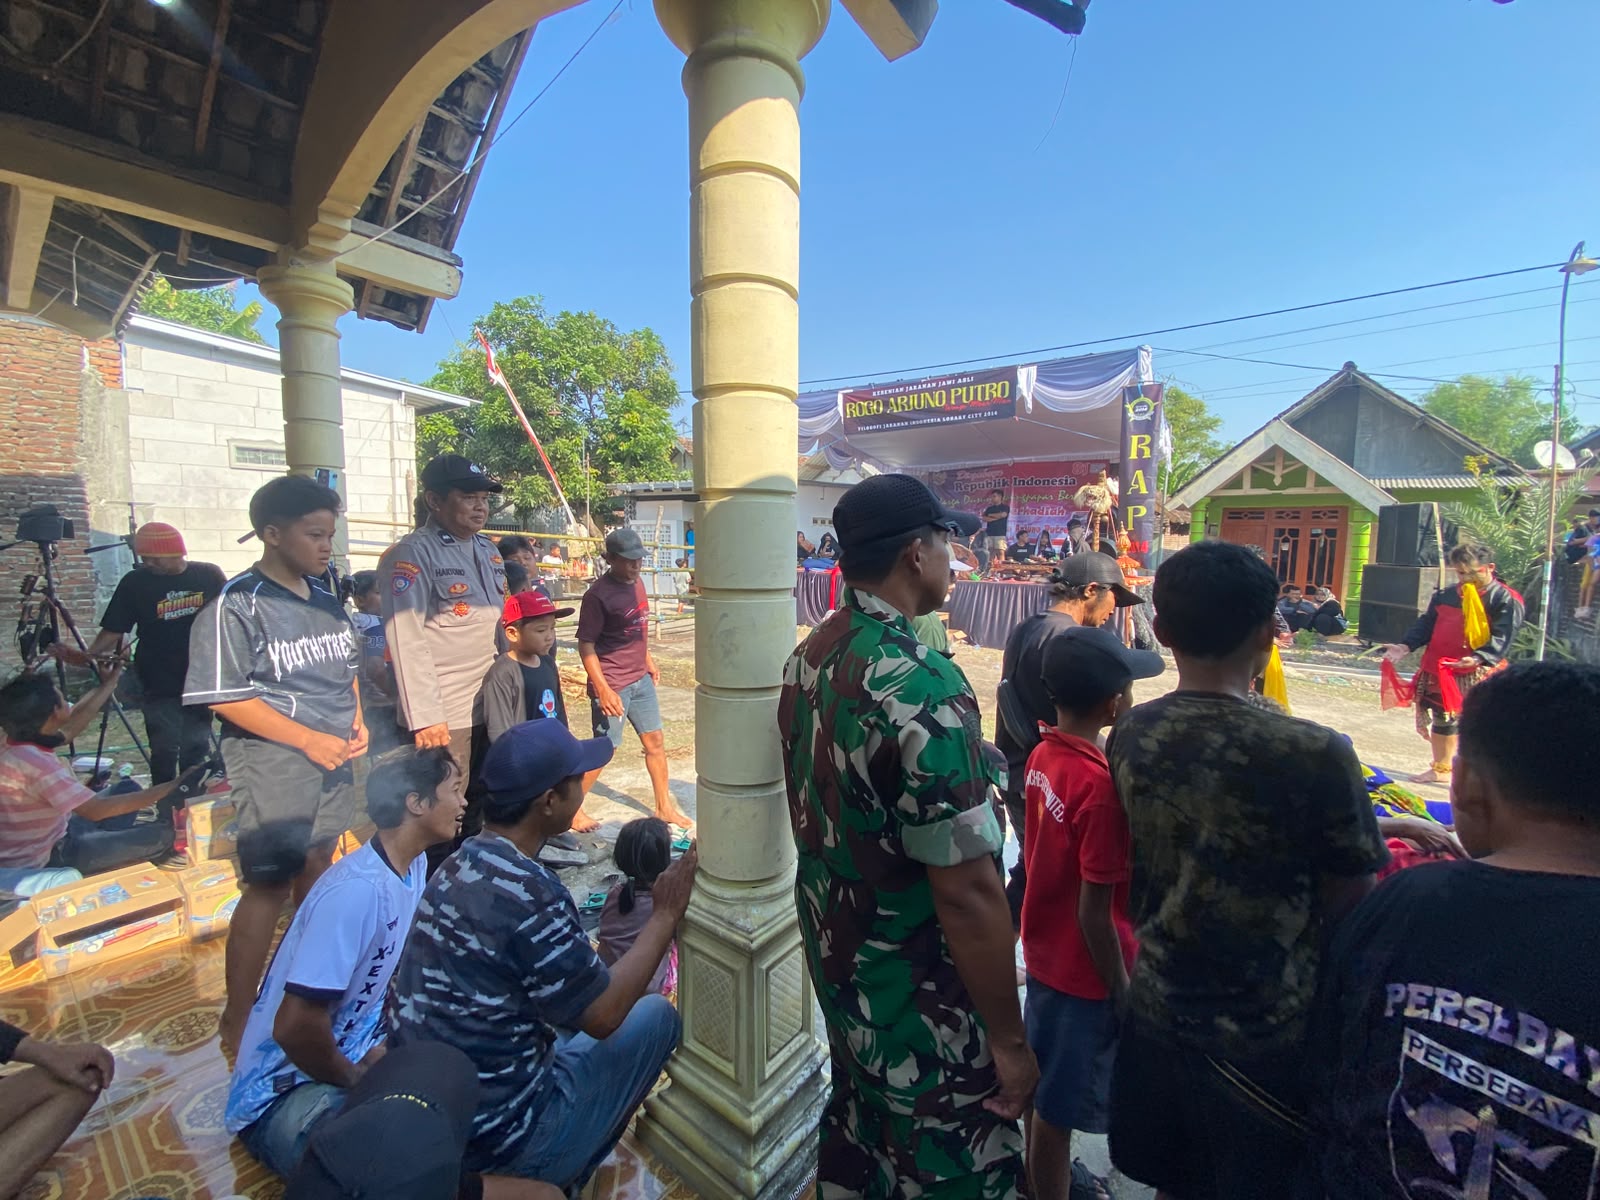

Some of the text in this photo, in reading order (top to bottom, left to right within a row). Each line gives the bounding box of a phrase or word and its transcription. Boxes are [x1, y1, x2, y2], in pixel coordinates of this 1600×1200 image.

[846, 400, 883, 418] ROGO
[887, 390, 946, 413] ARJUNO
[950, 380, 1010, 405] PUTRO
[954, 475, 1077, 493] Republik Indonesia
[1407, 1034, 1594, 1139] PERSEBAYA
